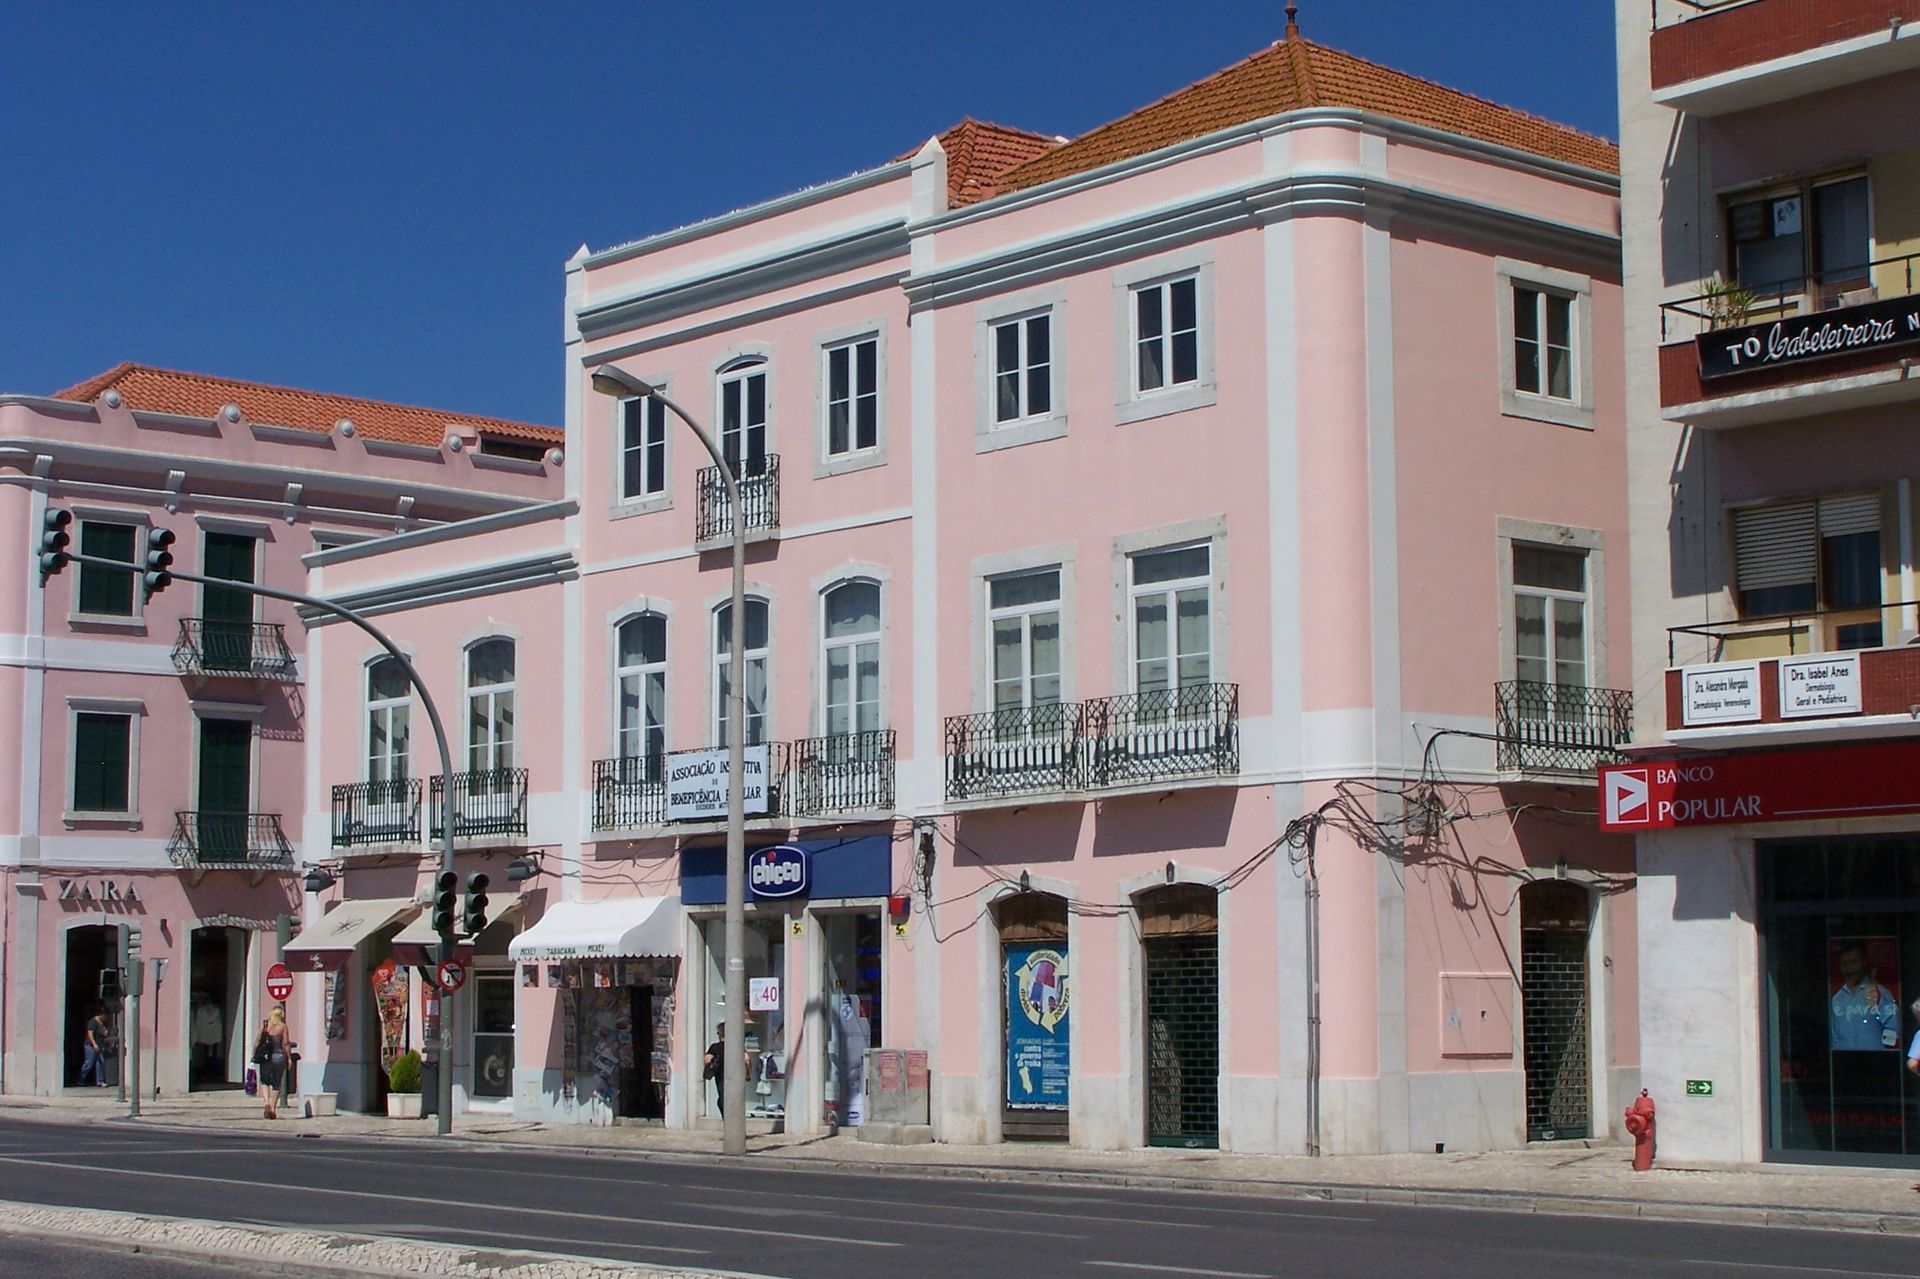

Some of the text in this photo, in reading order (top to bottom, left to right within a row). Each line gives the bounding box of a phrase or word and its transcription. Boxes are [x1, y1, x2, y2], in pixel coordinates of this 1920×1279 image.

[1791, 665, 1849, 682] Dra. Isabel Anes
[1796, 697, 1811, 707] Geral
[671, 760, 715, 782] ASSOCIAÇÃO
[1656, 766, 1714, 784] BANCO
[671, 788, 721, 806] BENEFICÊNCIA
[1658, 795, 1762, 822] POPULAR
[753, 850, 800, 885] chicco
[58, 880, 141, 901] ZARA
[762, 986, 778, 1002] 40
